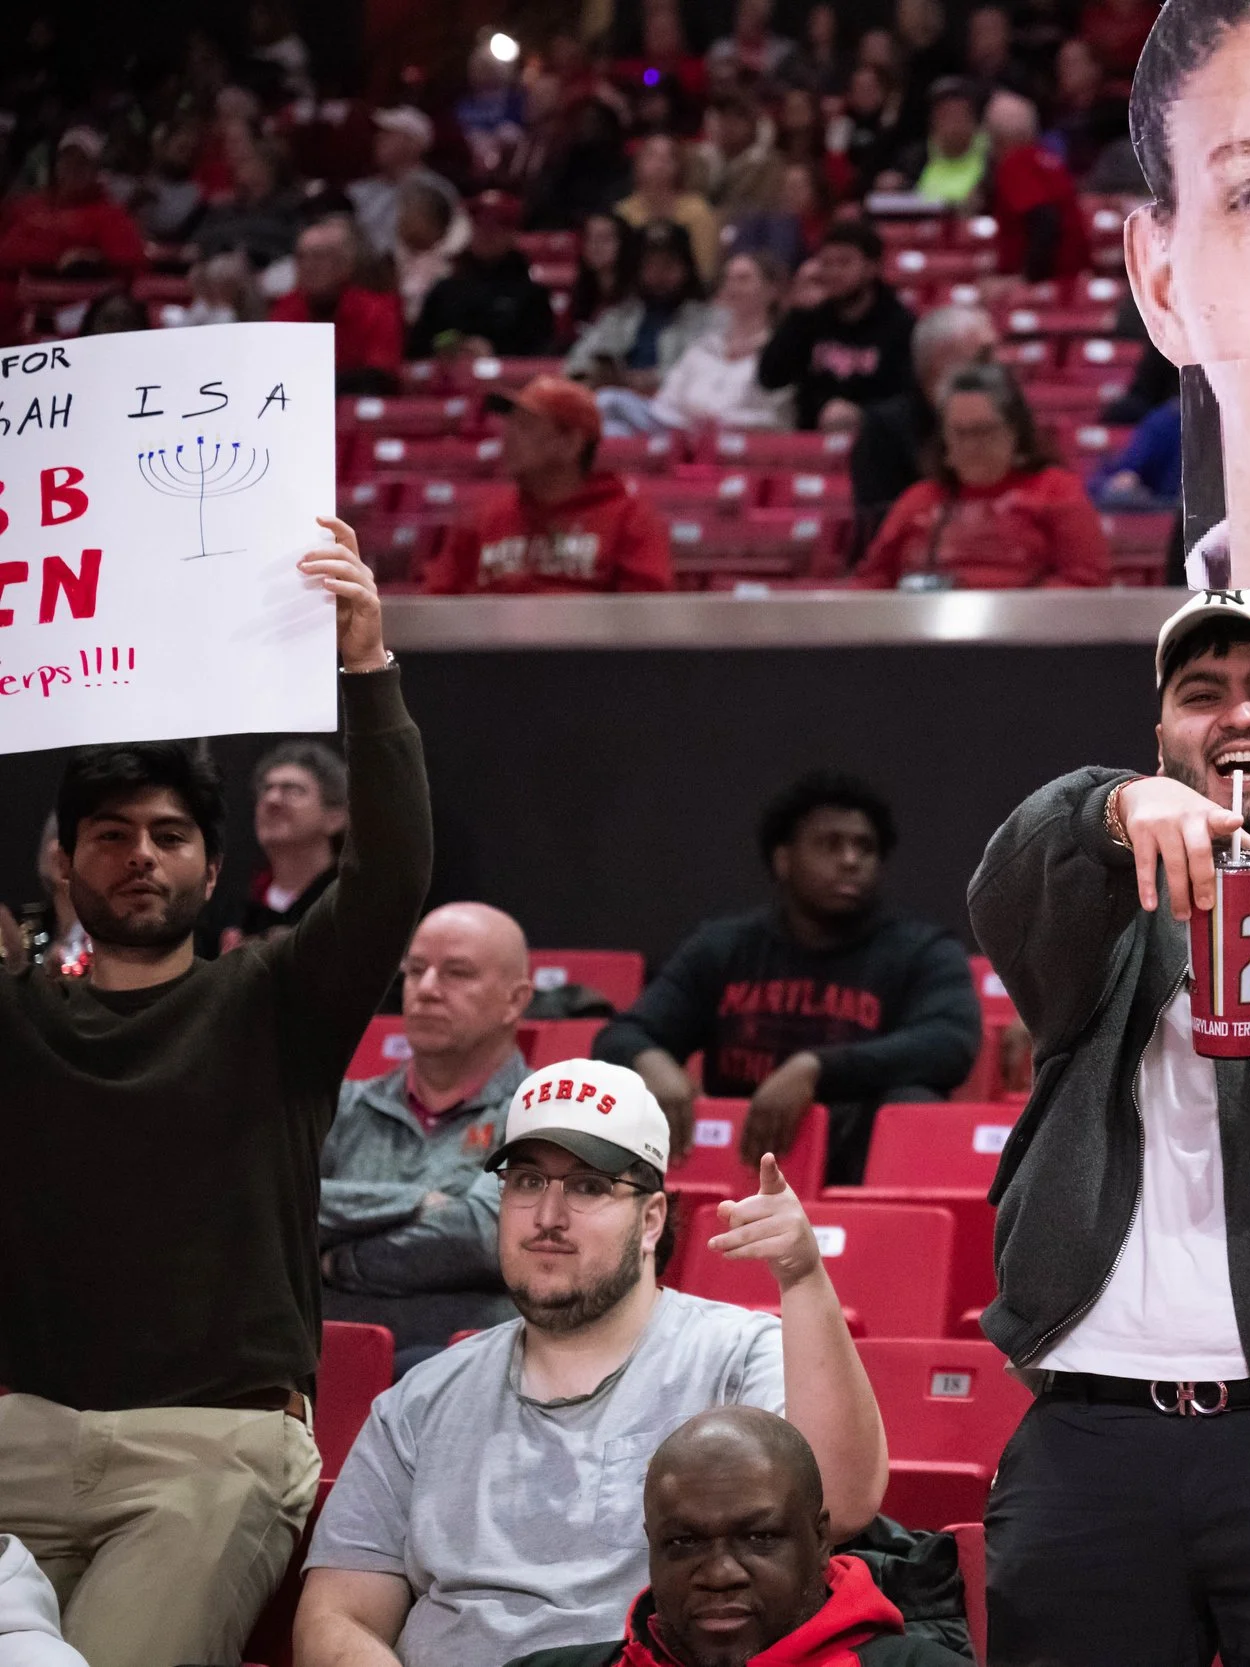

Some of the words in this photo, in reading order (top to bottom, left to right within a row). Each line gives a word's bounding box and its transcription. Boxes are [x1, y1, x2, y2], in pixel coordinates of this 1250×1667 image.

[2, 347, 71, 378] FOR
[0, 647, 134, 698] erps!!!!
[522, 1079, 617, 1115] TERPS
